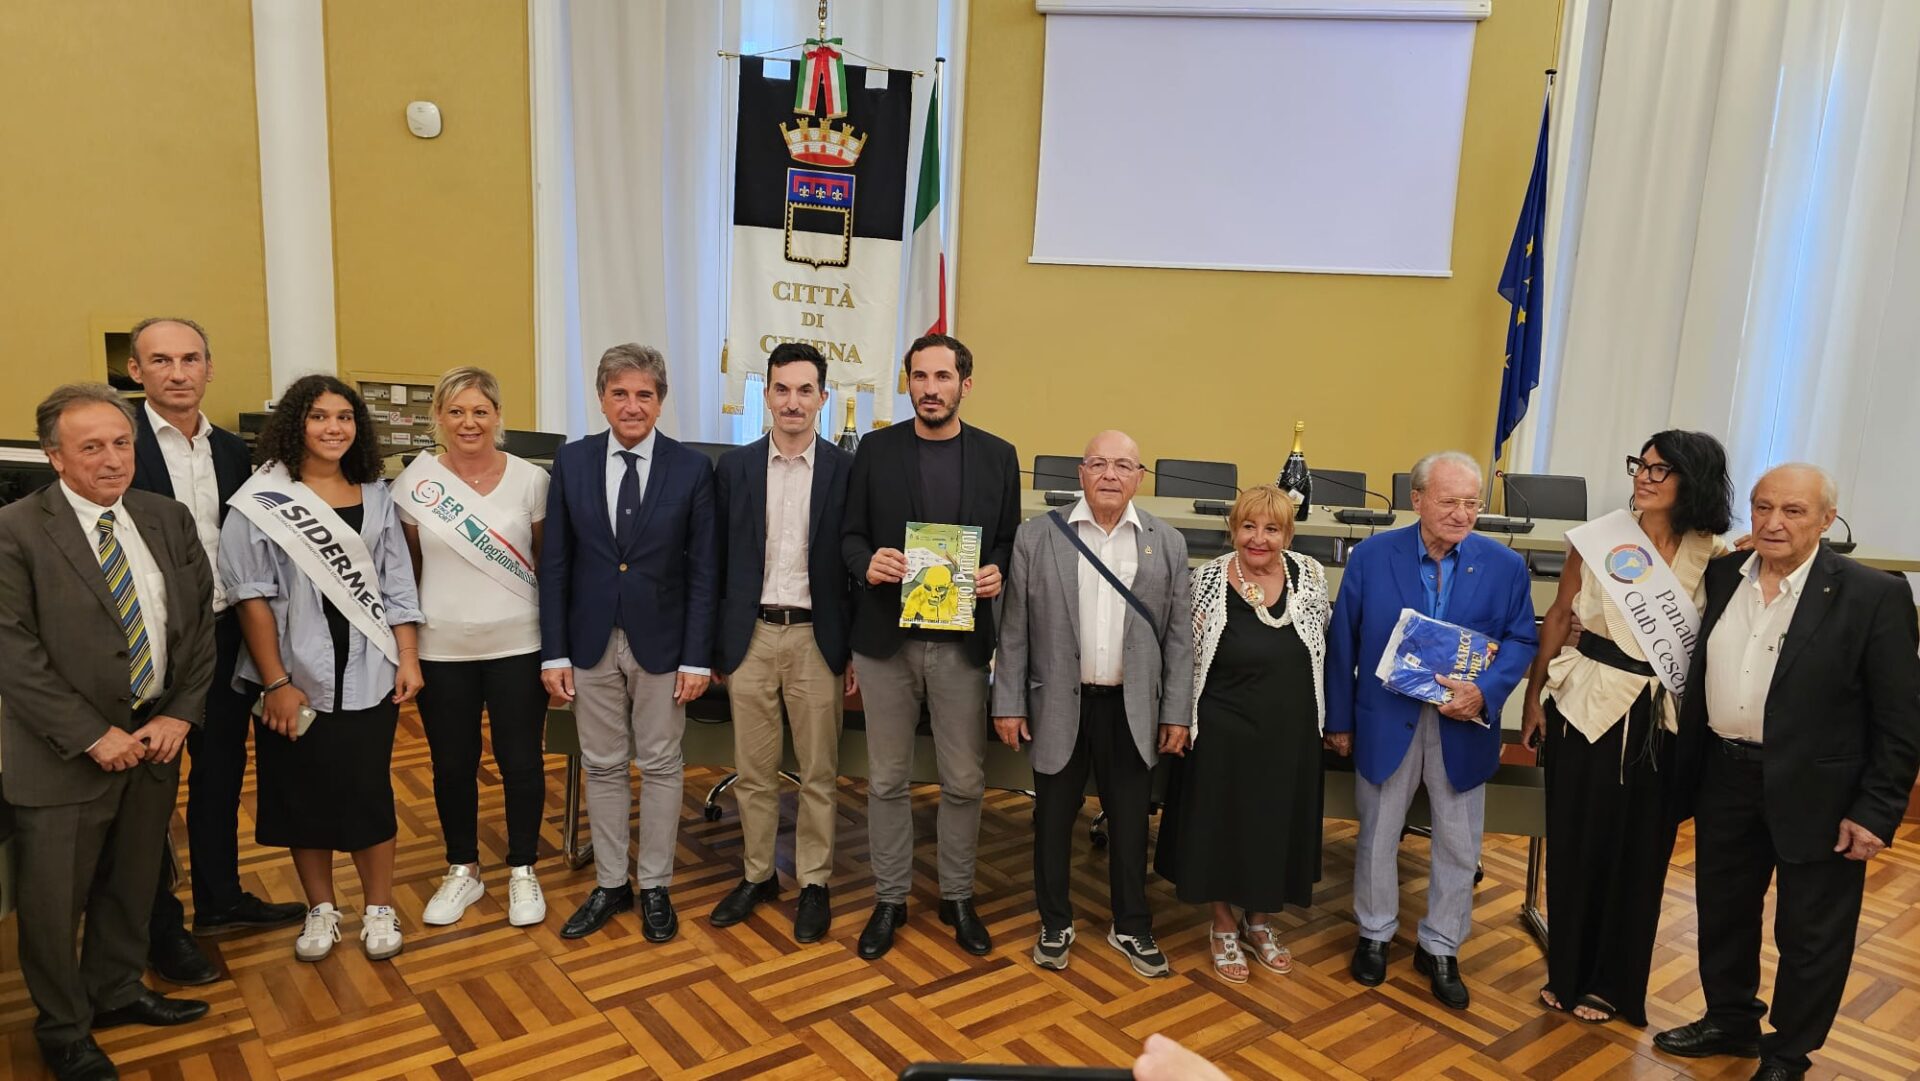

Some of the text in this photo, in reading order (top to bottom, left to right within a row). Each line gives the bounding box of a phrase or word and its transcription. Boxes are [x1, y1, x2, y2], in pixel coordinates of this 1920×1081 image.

[772, 281, 855, 309] CITTÀ
[801, 311, 825, 328] DI
[281, 505, 386, 620] SIDERMEC
[1624, 590, 1687, 699] Club Cesen
[1655, 589, 1699, 659] Panath
